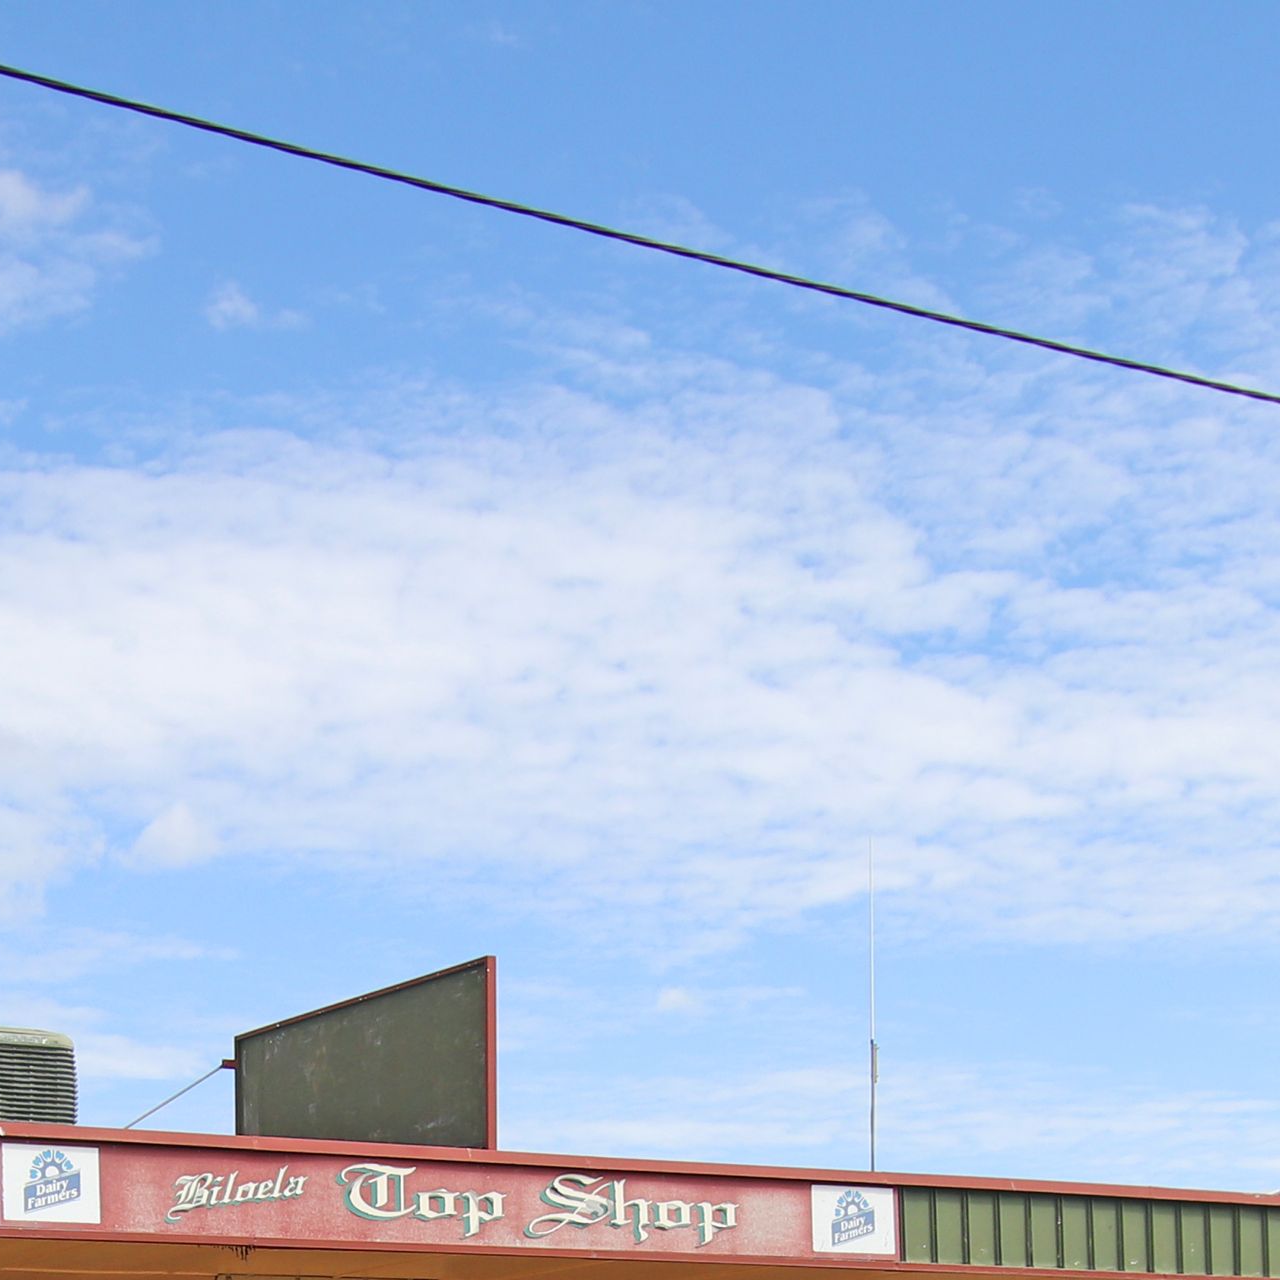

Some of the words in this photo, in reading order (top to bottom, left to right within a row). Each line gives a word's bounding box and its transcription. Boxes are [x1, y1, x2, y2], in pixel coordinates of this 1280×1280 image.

[36, 1180, 69, 1196] Dairy
[27, 1188, 78, 1210] Farmers
[336, 1163, 508, 1239] Top
[522, 1173, 740, 1249] Shop
[834, 1224, 873, 1244] Farmers
[841, 1216, 866, 1232] Dairy
